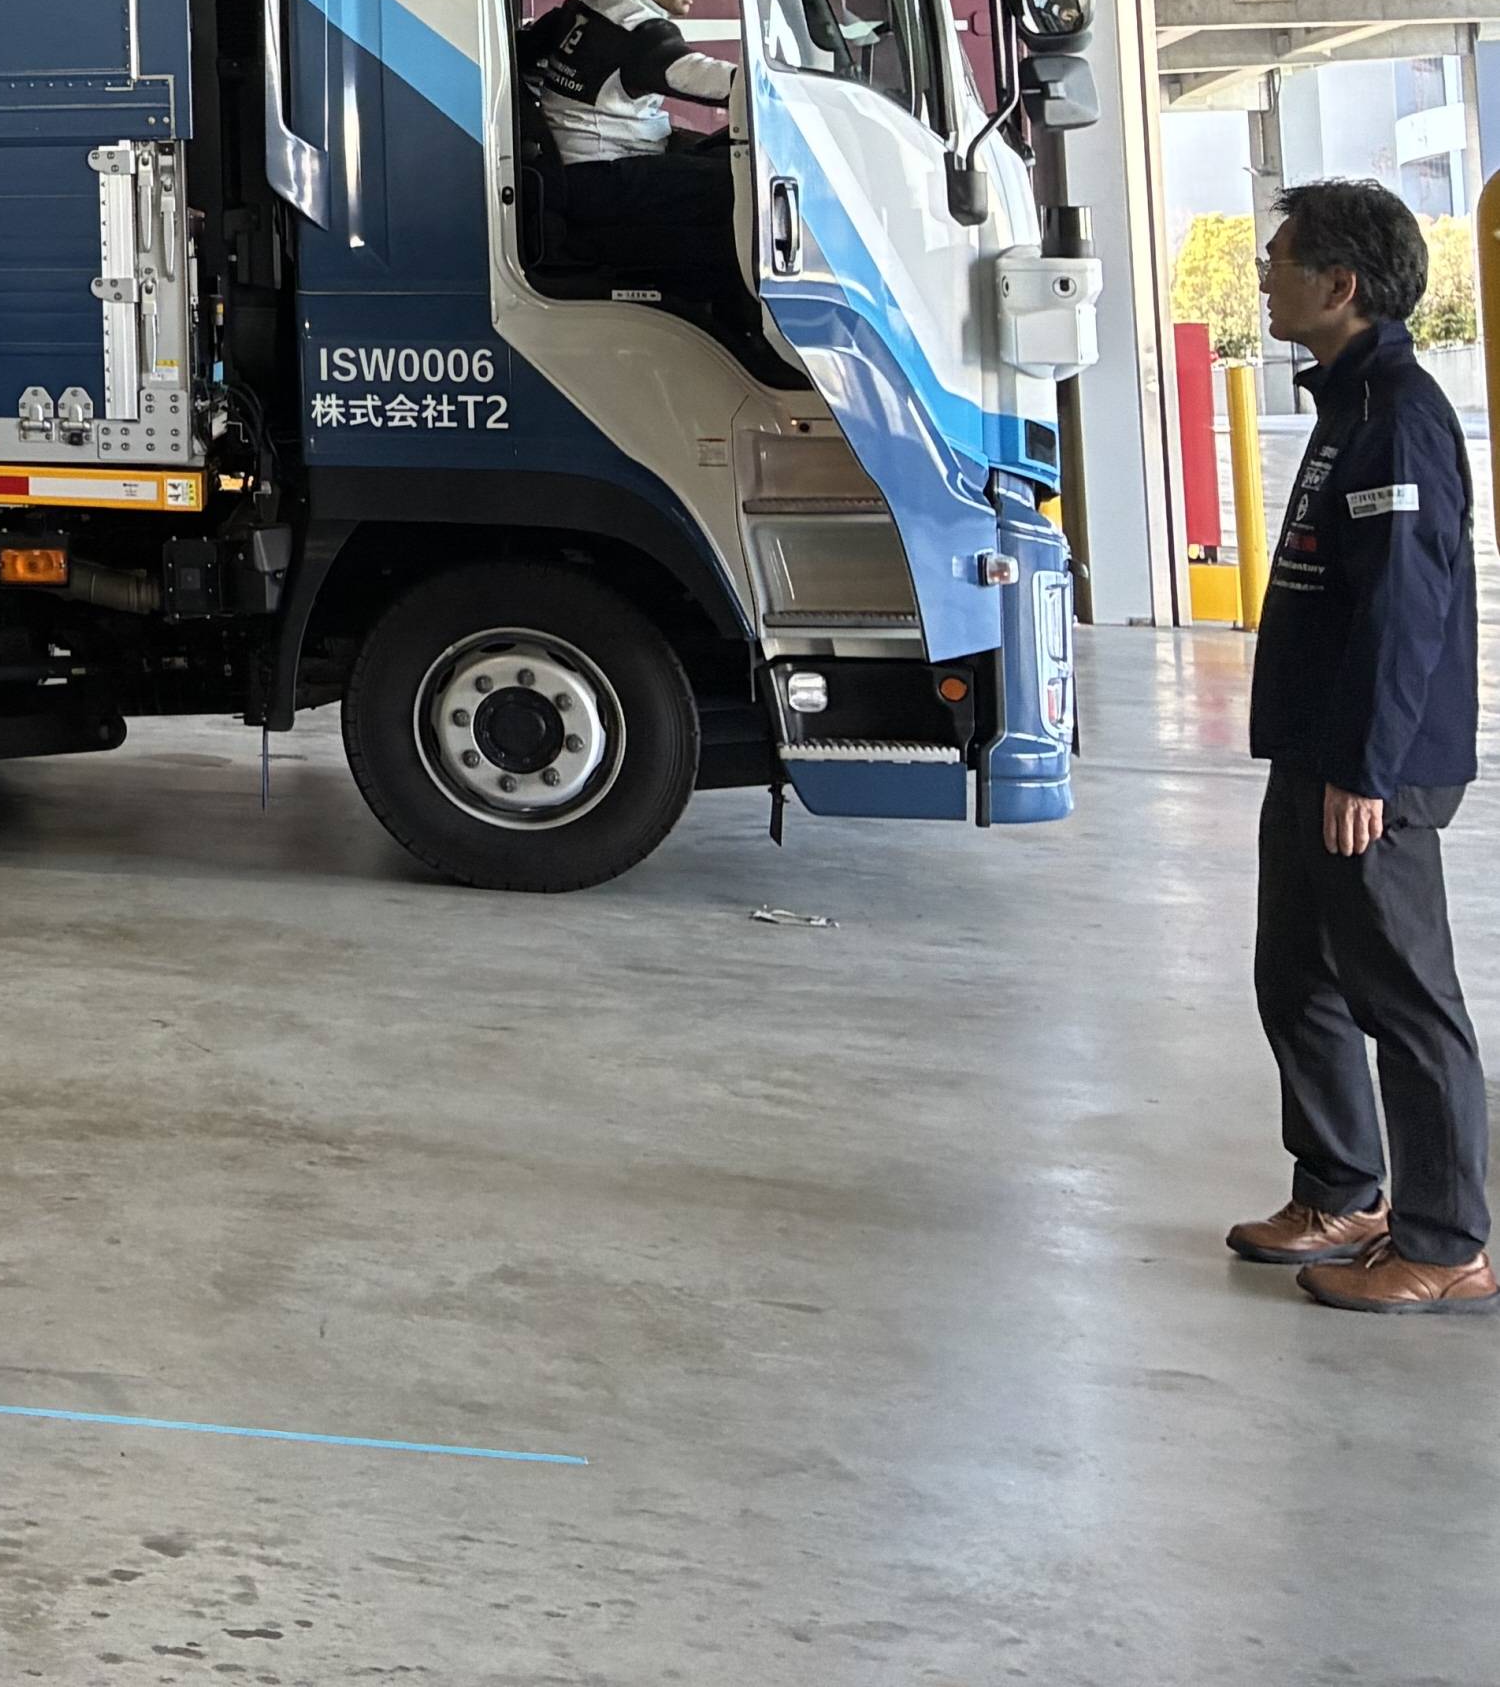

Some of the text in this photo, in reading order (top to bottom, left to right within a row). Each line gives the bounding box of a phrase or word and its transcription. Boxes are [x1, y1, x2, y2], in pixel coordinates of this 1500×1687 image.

[319, 347, 495, 383] ISW0006
[311, 393, 510, 429] 株式会社T2
